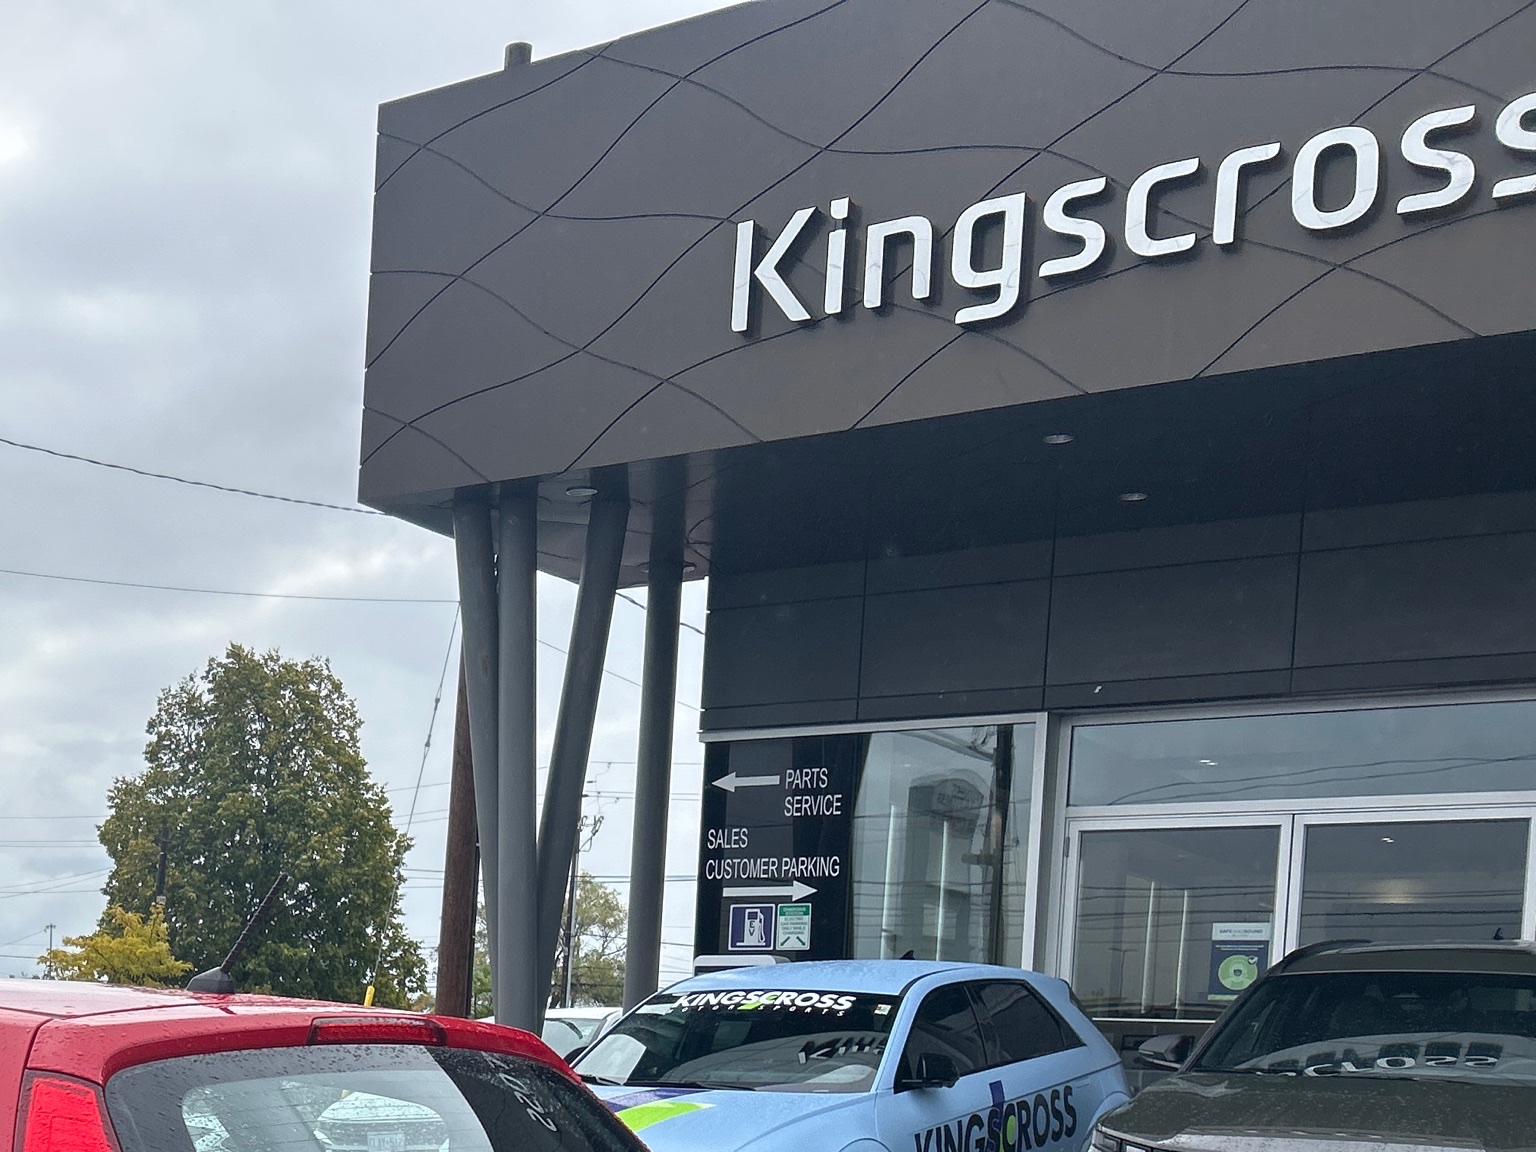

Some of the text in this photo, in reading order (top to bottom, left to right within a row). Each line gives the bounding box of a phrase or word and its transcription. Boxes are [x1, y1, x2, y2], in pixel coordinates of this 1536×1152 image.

[785, 767, 829, 790] PARTS
[784, 794, 843, 817] SERVICE
[707, 828, 749, 850] SALES
[705, 855, 841, 880] CUSTOMER PARKING
[672, 990, 857, 1011] KINGSCROSS
